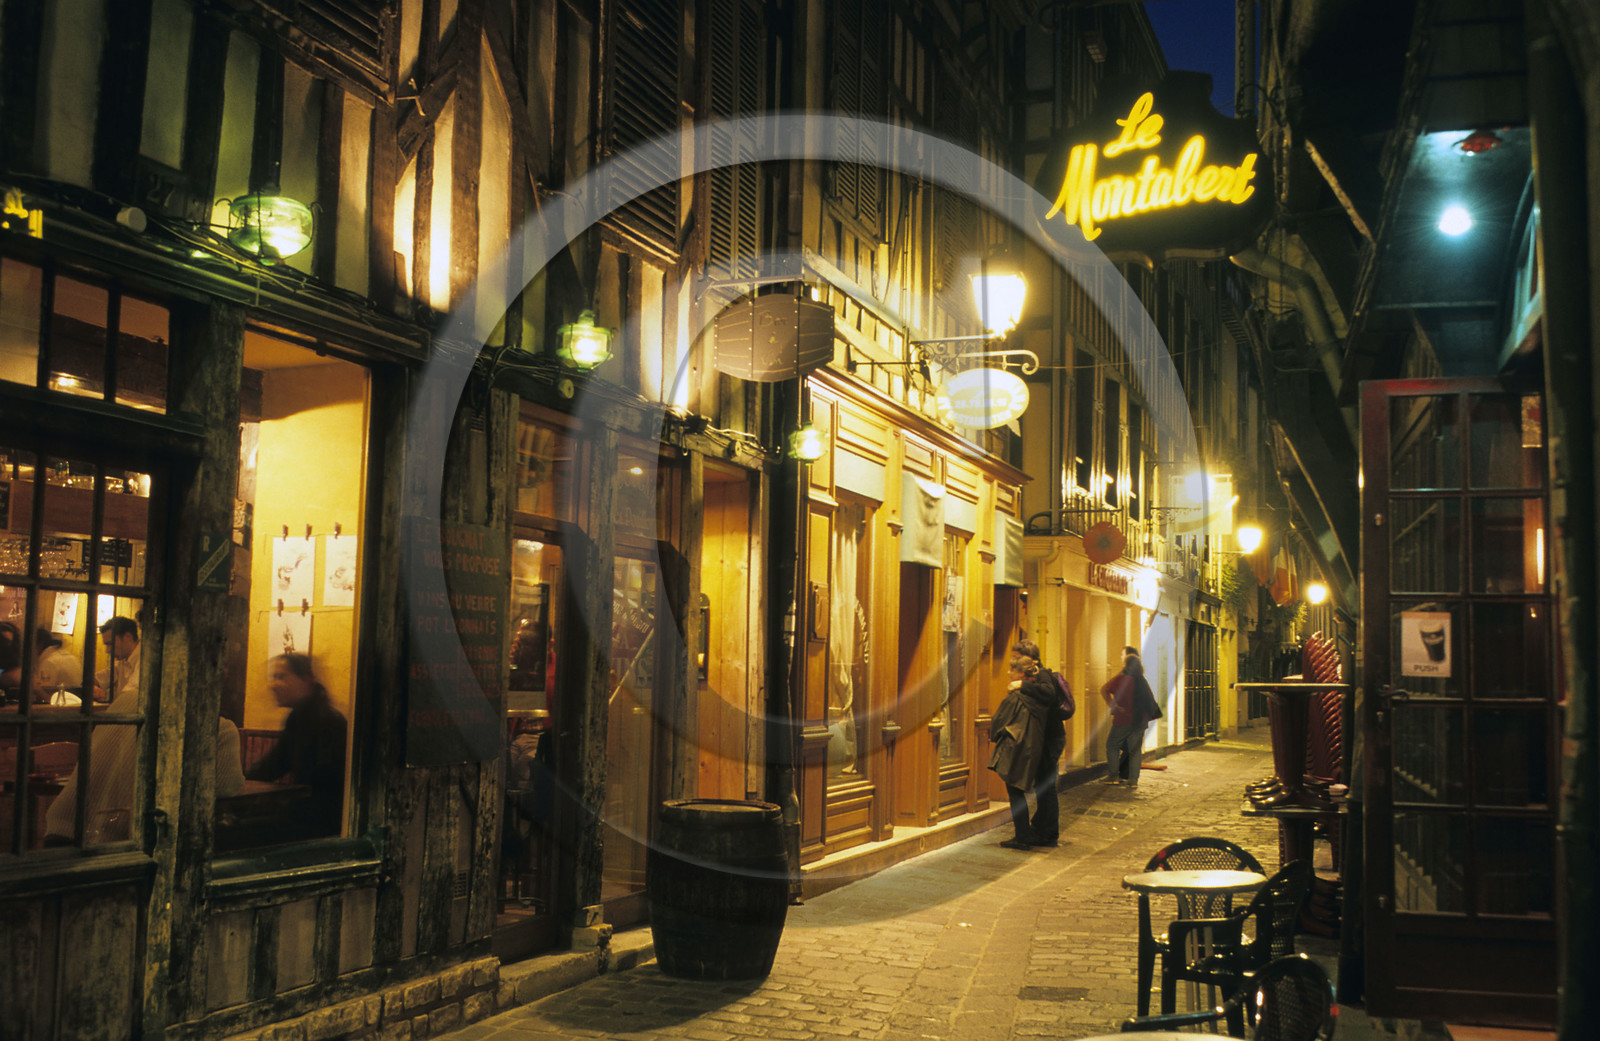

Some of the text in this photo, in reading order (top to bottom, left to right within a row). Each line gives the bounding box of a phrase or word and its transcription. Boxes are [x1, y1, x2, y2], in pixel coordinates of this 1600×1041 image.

[1103, 91, 1164, 158] Le
[1045, 135, 1258, 241] Montabert
[424, 549, 500, 575] VOUS PROPOSE
[465, 596, 496, 612] VERRE
[416, 615, 440, 633] POT
[1413, 664, 1439, 672] PUSH
